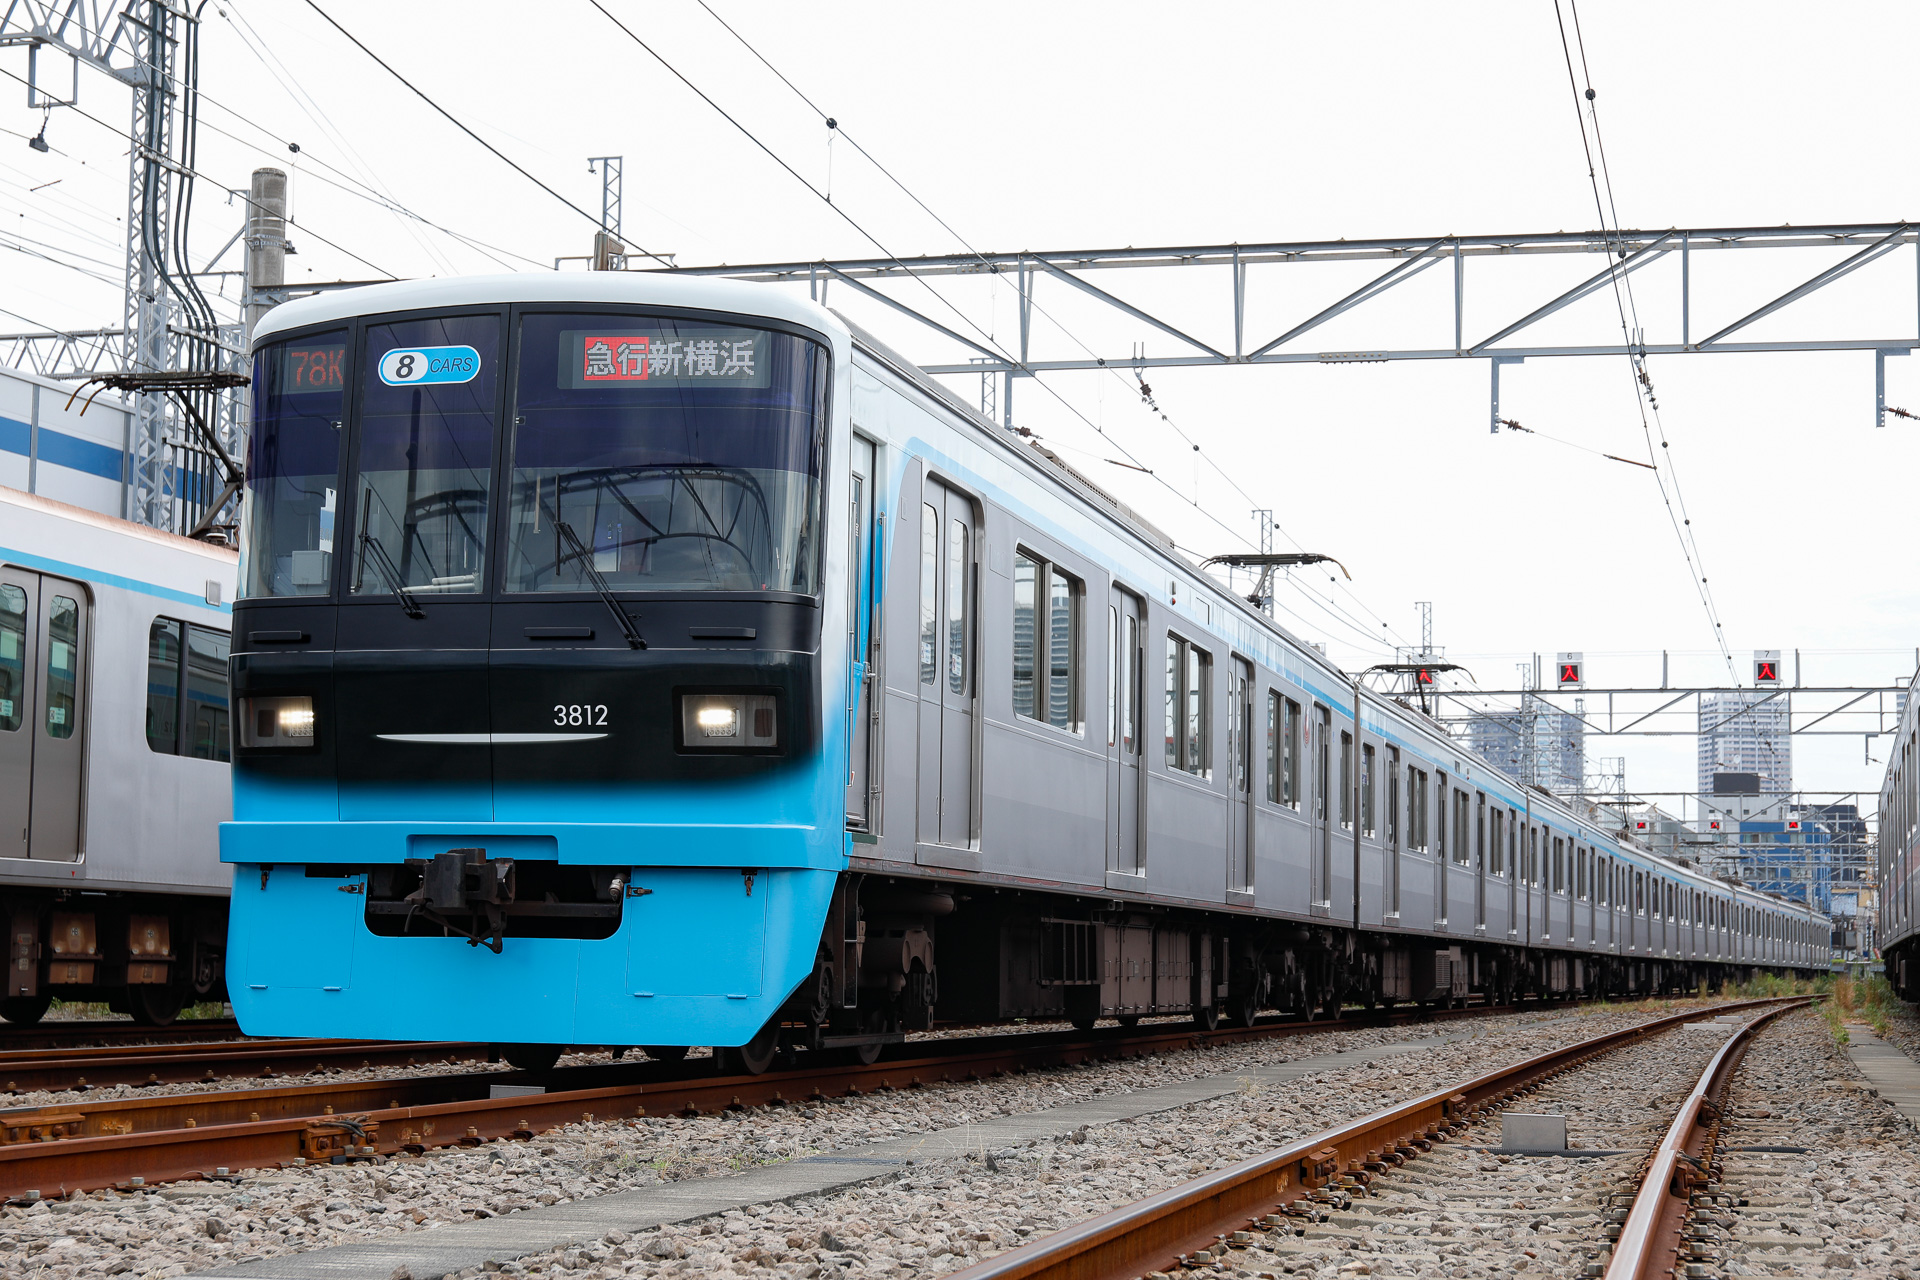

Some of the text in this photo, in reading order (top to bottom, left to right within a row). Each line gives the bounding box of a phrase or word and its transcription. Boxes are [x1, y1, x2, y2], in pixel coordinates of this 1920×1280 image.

[396, 355, 473, 378] 8 CARS
[586, 340, 755, 376] 急行 新横浜
[292, 350, 344, 386] 78K
[1567, 652, 1573, 660] 6
[1764, 650, 1770, 658] 7
[1561, 665, 1579, 682] 入
[1757, 663, 1776, 680] 入
[554, 705, 608, 726] 3812
